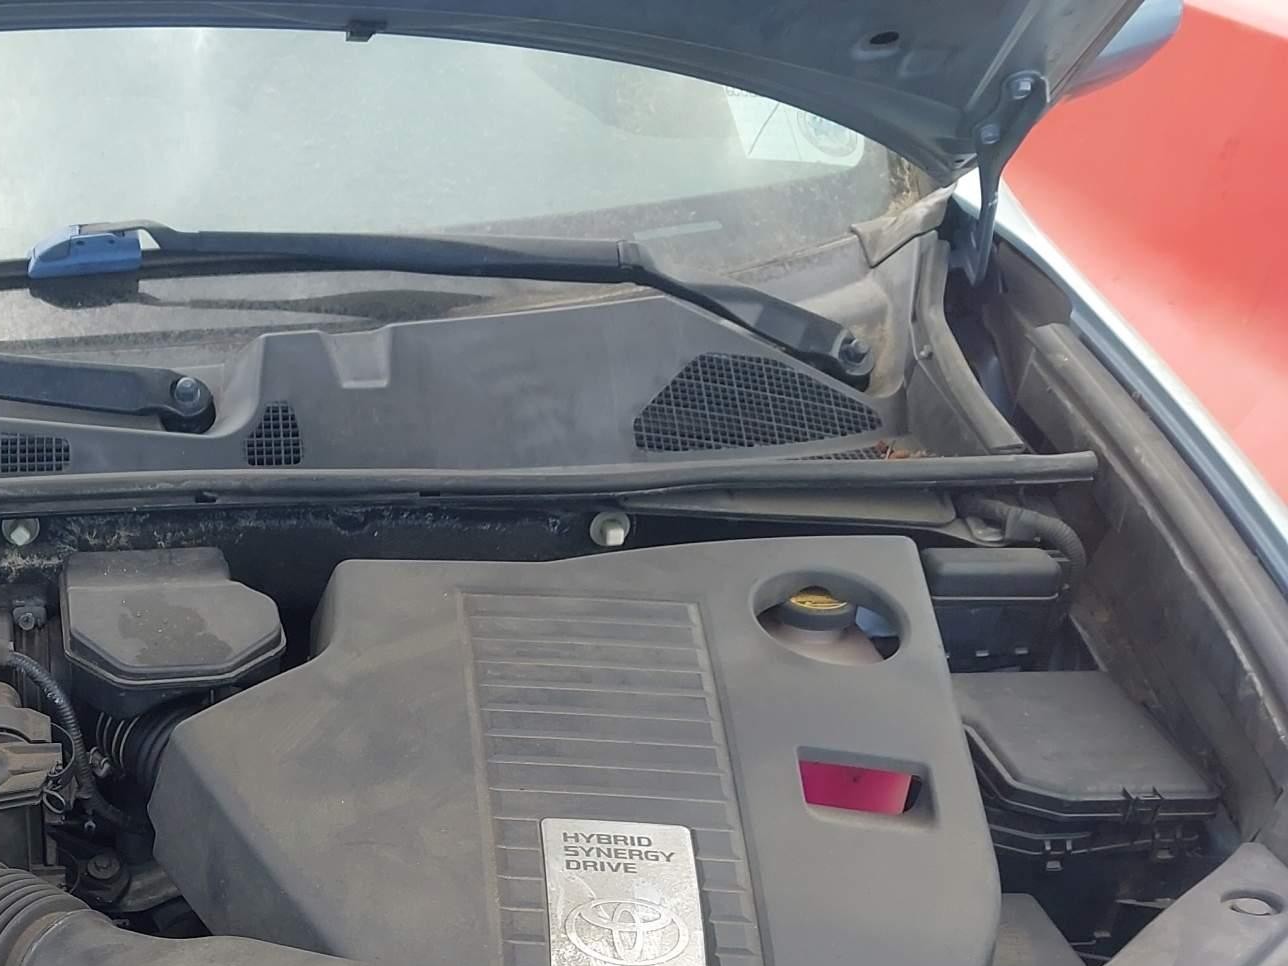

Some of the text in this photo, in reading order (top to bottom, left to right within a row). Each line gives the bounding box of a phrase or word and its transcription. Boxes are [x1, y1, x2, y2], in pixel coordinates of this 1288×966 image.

[562, 832, 653, 847] HYBRID
[563, 845, 675, 862] SYNERGY
[565, 859, 638, 873] DRIVE
